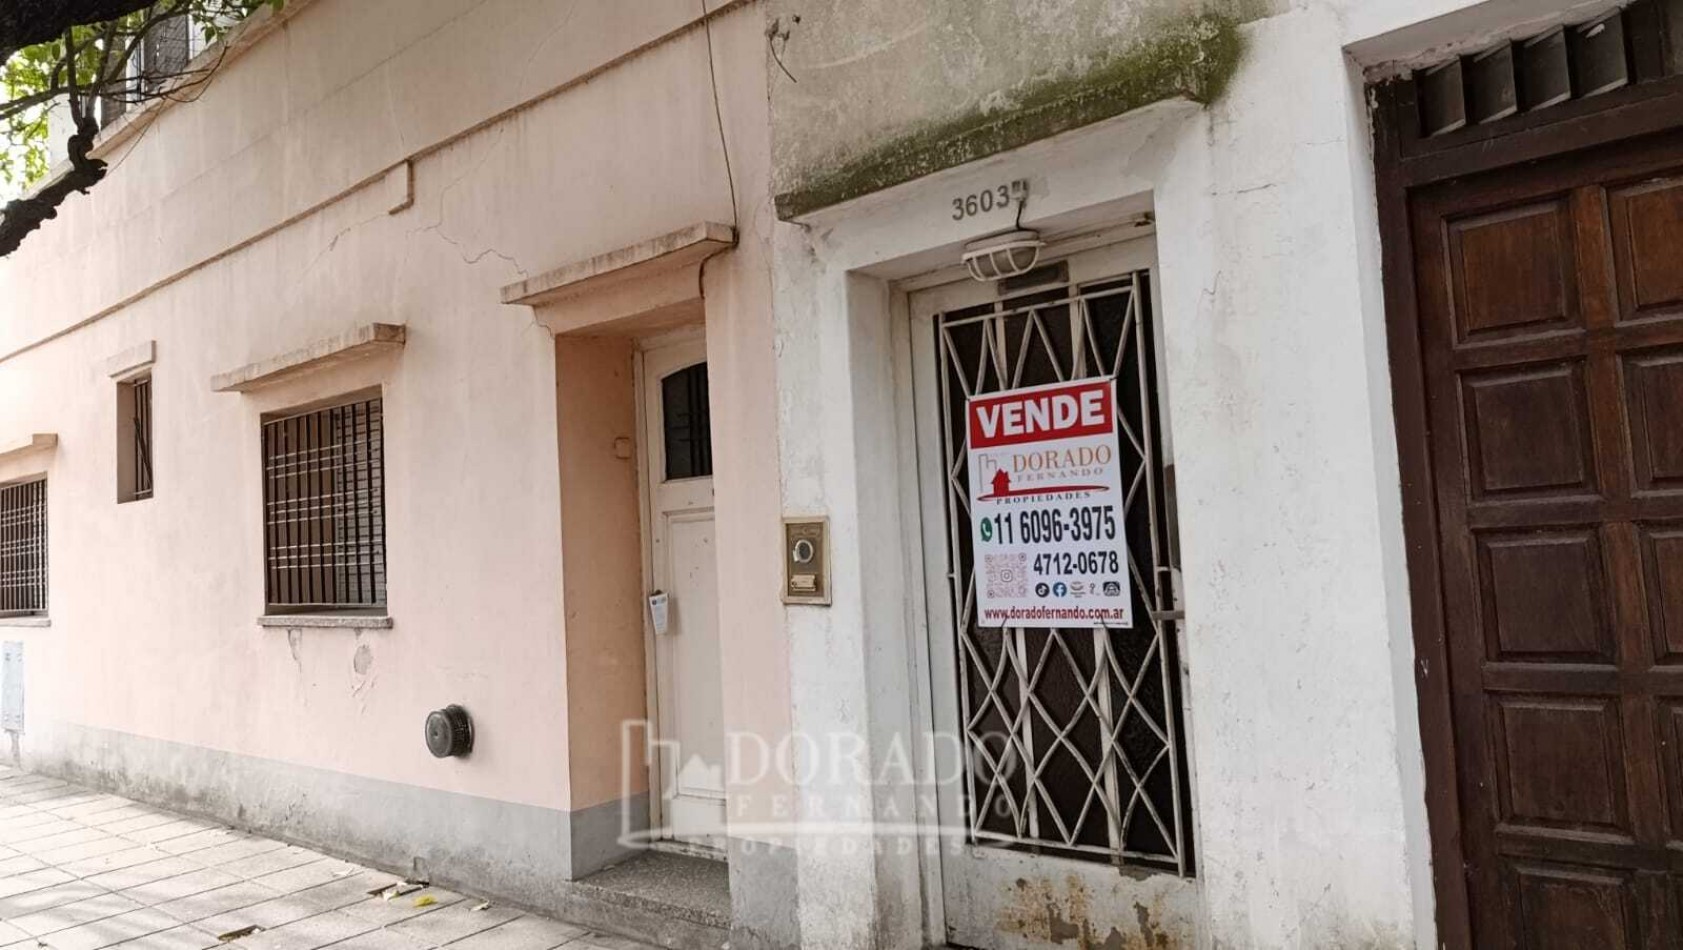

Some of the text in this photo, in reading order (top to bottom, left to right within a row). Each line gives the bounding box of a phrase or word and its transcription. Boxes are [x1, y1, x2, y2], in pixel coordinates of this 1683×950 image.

[952, 185, 1010, 221] 3603
[976, 389, 1105, 438] VENDE
[1012, 444, 1112, 473] DORADO
[1017, 467, 1103, 482] FERNANDO
[996, 491, 1091, 505] PROPIEDADES
[994, 505, 1116, 544] 11 6096-3975
[1033, 551, 1119, 575] 4712-0678
[984, 605, 1124, 620] www.doradofernando.com.ar
